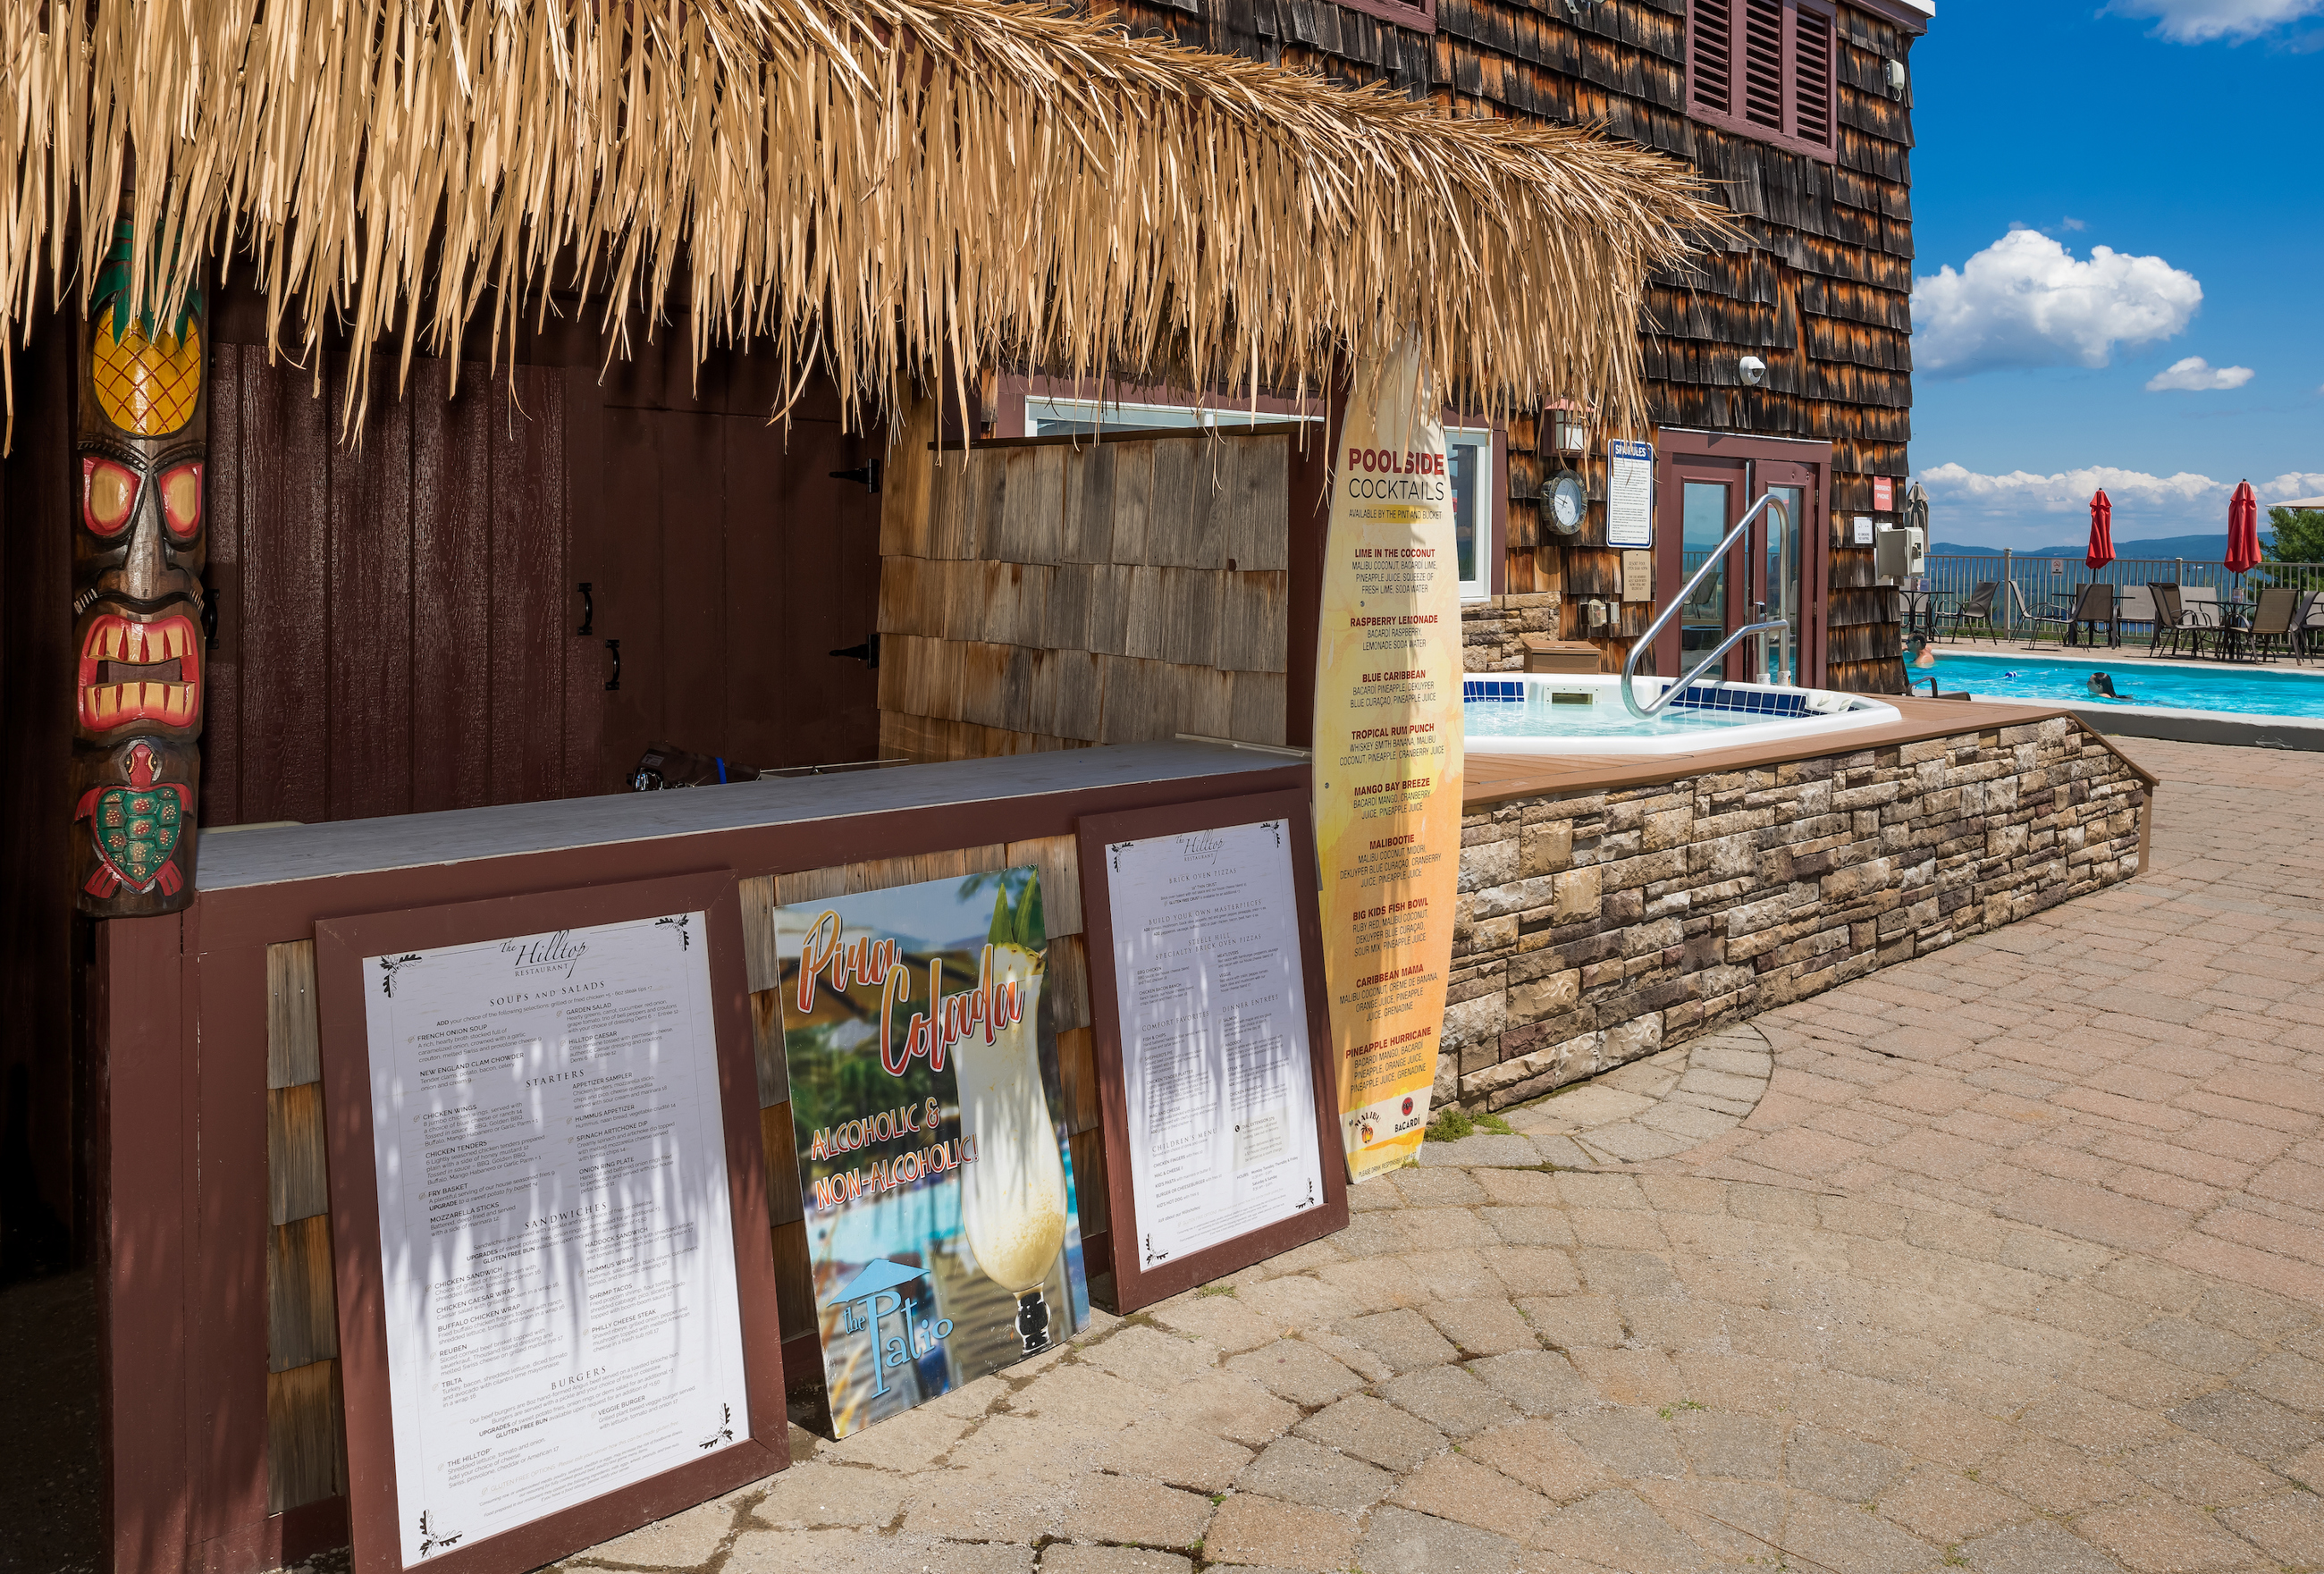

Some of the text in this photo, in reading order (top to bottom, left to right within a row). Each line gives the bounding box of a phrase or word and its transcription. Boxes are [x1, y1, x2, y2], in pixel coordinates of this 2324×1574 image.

[1349, 448, 1444, 476] POOLSIDE
[1349, 478, 1444, 501] COCKTAILS
[1349, 509, 1442, 519] AVAILABLE BY THE PINT AND BUCKET
[1355, 549, 1435, 558] LIME IN THE COCONUT
[1352, 560, 1437, 569] MALIBU COCONUT, BACARDÍ LIME,
[1356, 573, 1434, 582] PINEAPPLE JUICE, SQUEEZE OF
[1362, 585, 1428, 593] FRESH LIME, SODA WATER
[1351, 615, 1437, 627] RASPBERRY LEMONADE
[1363, 639, 1426, 651] LEMONADE SODA WATER
[1362, 670, 1426, 683] BLUE CARIBBEAN
[1351, 693, 1436, 708] BLUE CURAÇAO, PINEAPPLE JUICE
[1351, 723, 1434, 740] TROPICAL RUM PUNCH
[1354, 778, 1430, 795] MANGO BAY BREEZE
[1184, 829, 1225, 864] Hilltop
[1370, 835, 1414, 849] MALIBOOTIE
[1184, 854, 1214, 862] RESTAURANT
[1169, 868, 1237, 884] BRICK OVEN PIZZAS
[1149, 899, 1262, 925] BUILD YOUR OWN MASTERPIECES
[1353, 897, 1428, 921] BIG KIDS FISH BOWL
[500, 929, 590, 980] The Hilltop
[1156, 933, 1262, 961] SPECIALTY BRICK OVEN PIZZAS
[515, 963, 568, 977] RESTAURANT
[1356, 964, 1423, 988] CARIBBEAN MAMA
[490, 981, 606, 1007] SOUPS AND SALADS
[1223, 994, 1279, 1013] DINNER ENTREES
[567, 1002, 611, 1015] GARDEN SALAD
[880, 943, 1024, 1077] Colada
[1142, 1011, 1209, 1031] COMFORT FAVORITES
[417, 1024, 487, 1041] FRENCH ONION SOUP
[569, 1031, 618, 1044] HILLTOP CAESAR
[1346, 1027, 1431, 1059] PINEAPPLE HURRICANE
[420, 1052, 524, 1077] NEW ENGLAND CLAM CHOWDER
[526, 1069, 585, 1089] STARTERS
[572, 1072, 633, 1089] APPETIZER SAMPLER
[423, 1105, 477, 1120] CHICKEN WINGS
[575, 1104, 635, 1122] HUMMUS APPETIZER
[1354, 1110, 1381, 1129] MALIBU
[577, 1120, 648, 1141] SPINACH ARTICHOKE DIP
[812, 1097, 940, 1161] ALCOHOLIC &
[1394, 1115, 1420, 1132] BACARDÍ
[425, 1141, 487, 1158] CHICKEN TENDERS
[1152, 1127, 1217, 1153] CHILDREN'S MENU
[579, 1157, 635, 1174] ONION RING PLATE
[814, 1132, 981, 1211] NON-ALCOHOLIC!
[428, 1183, 468, 1197] FRY BASKET
[430, 1202, 500, 1224] MOZZARELLA STICKS
[524, 1202, 608, 1230] SANDWICHES
[585, 1226, 648, 1248] HADDOCK SANDWICH
[587, 1257, 634, 1275] HUMMUS WRAP
[434, 1267, 502, 1289] CHICKEN SANDWICH
[436, 1287, 515, 1314] CHICKEN CAESAR WRAP
[589, 1284, 633, 1300] SHRIMP TACOS
[438, 1303, 521, 1332] BUFFALO CHICKEN WRAP
[592, 1309, 656, 1333] PHILLY CHEESE STEAK
[439, 1344, 467, 1357] REUBEN
[842, 1290, 954, 1400] the Patio
[442, 1377, 463, 1387] TBLTA
[551, 1366, 607, 1391] BURGERS
[598, 1395, 645, 1416] VEGGIE BURGER
